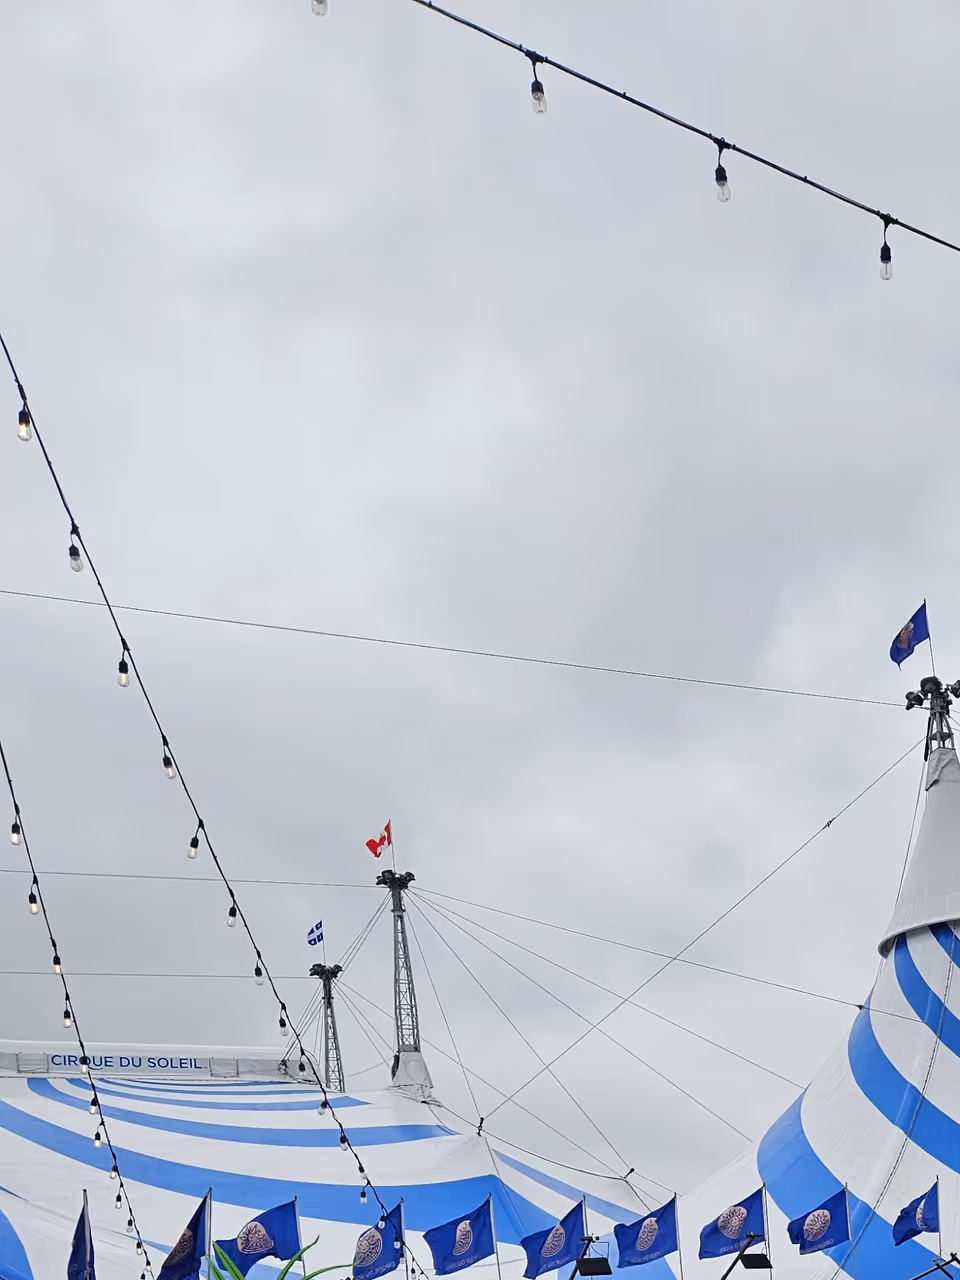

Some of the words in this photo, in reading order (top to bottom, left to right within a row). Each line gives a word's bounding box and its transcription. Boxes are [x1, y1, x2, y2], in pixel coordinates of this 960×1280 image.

[51, 1054, 114, 1070] CIRQUE
[119, 1056, 142, 1068] DU
[147, 1057, 202, 1069] SOLEIL
